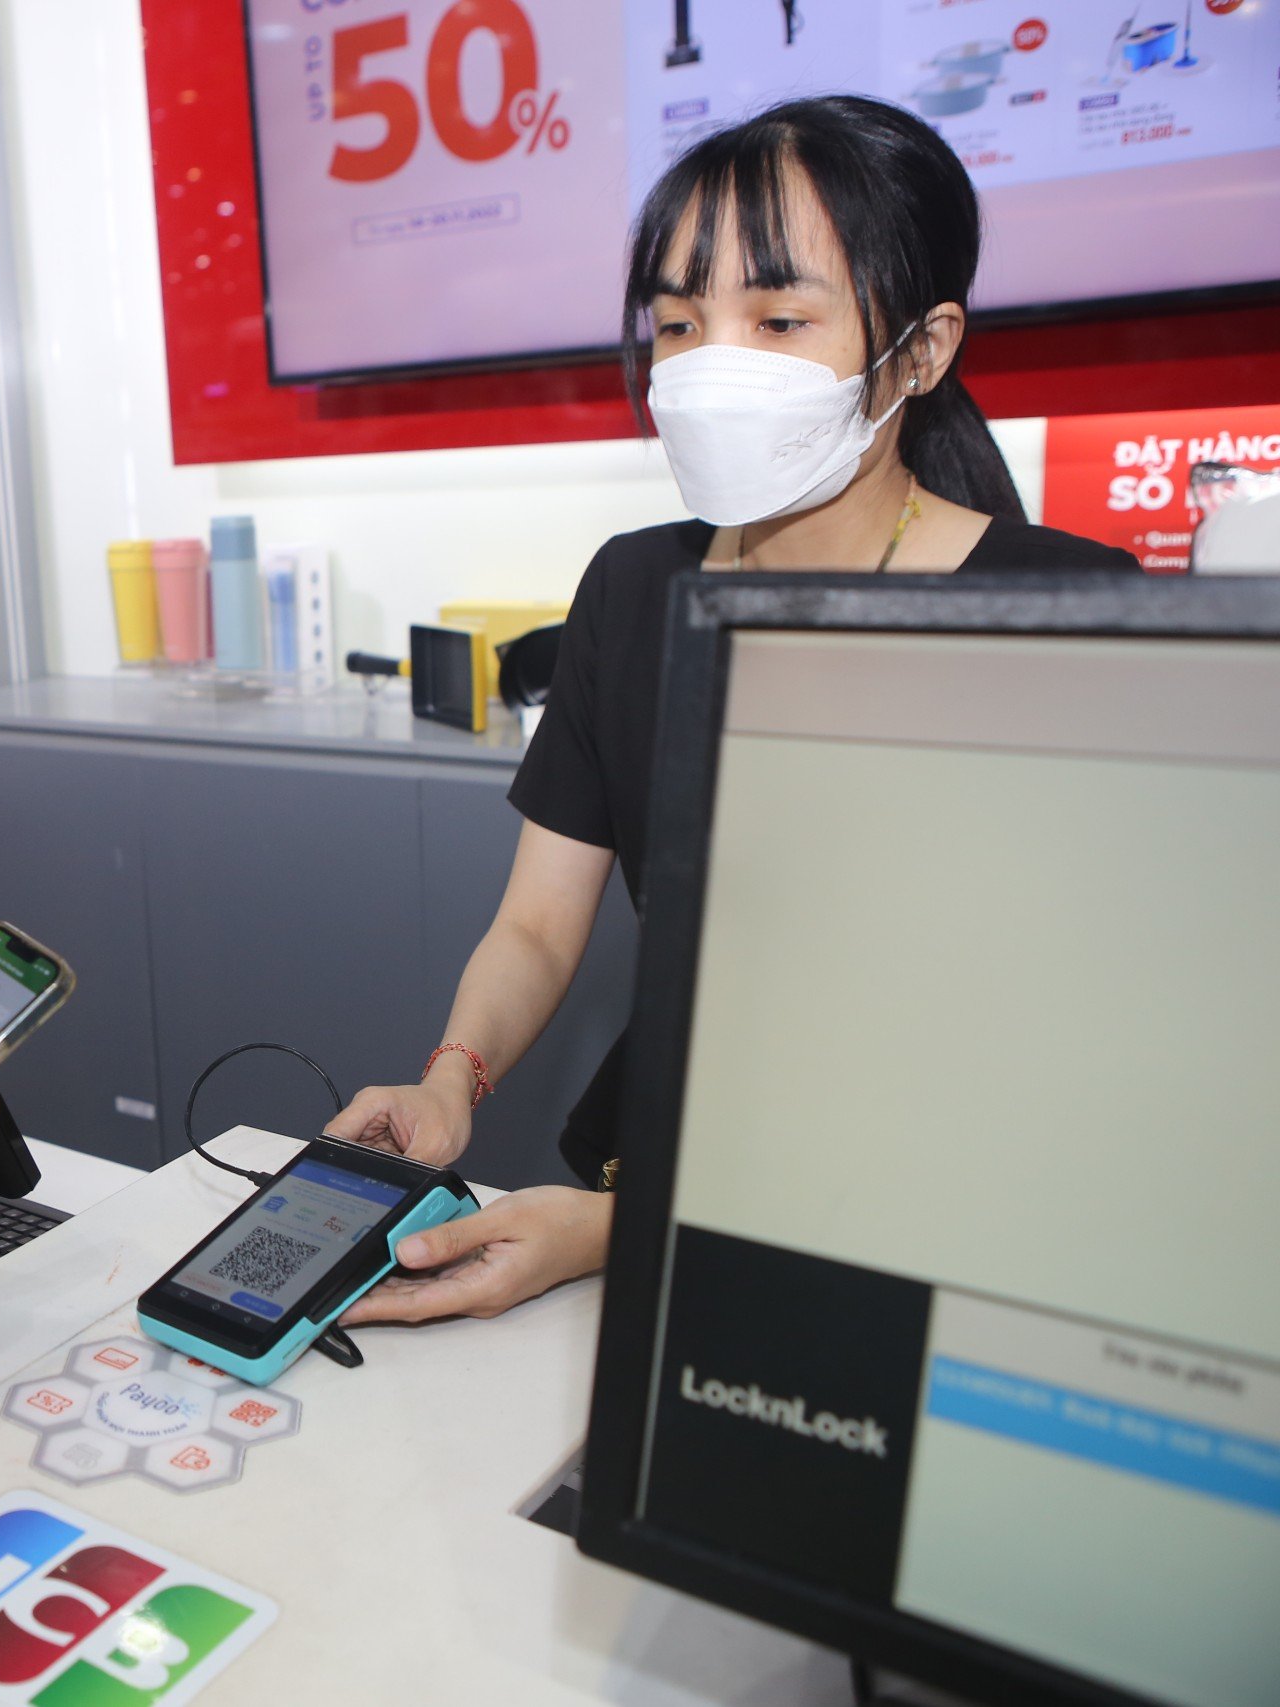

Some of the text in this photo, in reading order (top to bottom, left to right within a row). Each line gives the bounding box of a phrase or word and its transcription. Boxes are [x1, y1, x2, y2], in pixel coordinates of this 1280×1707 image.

[329, 0, 569, 183] 50%
[1187, 431, 1280, 465] HÀNG
[119, 1382, 179, 1415] Payoo
[680, 1364, 888, 1460] LocknLock
